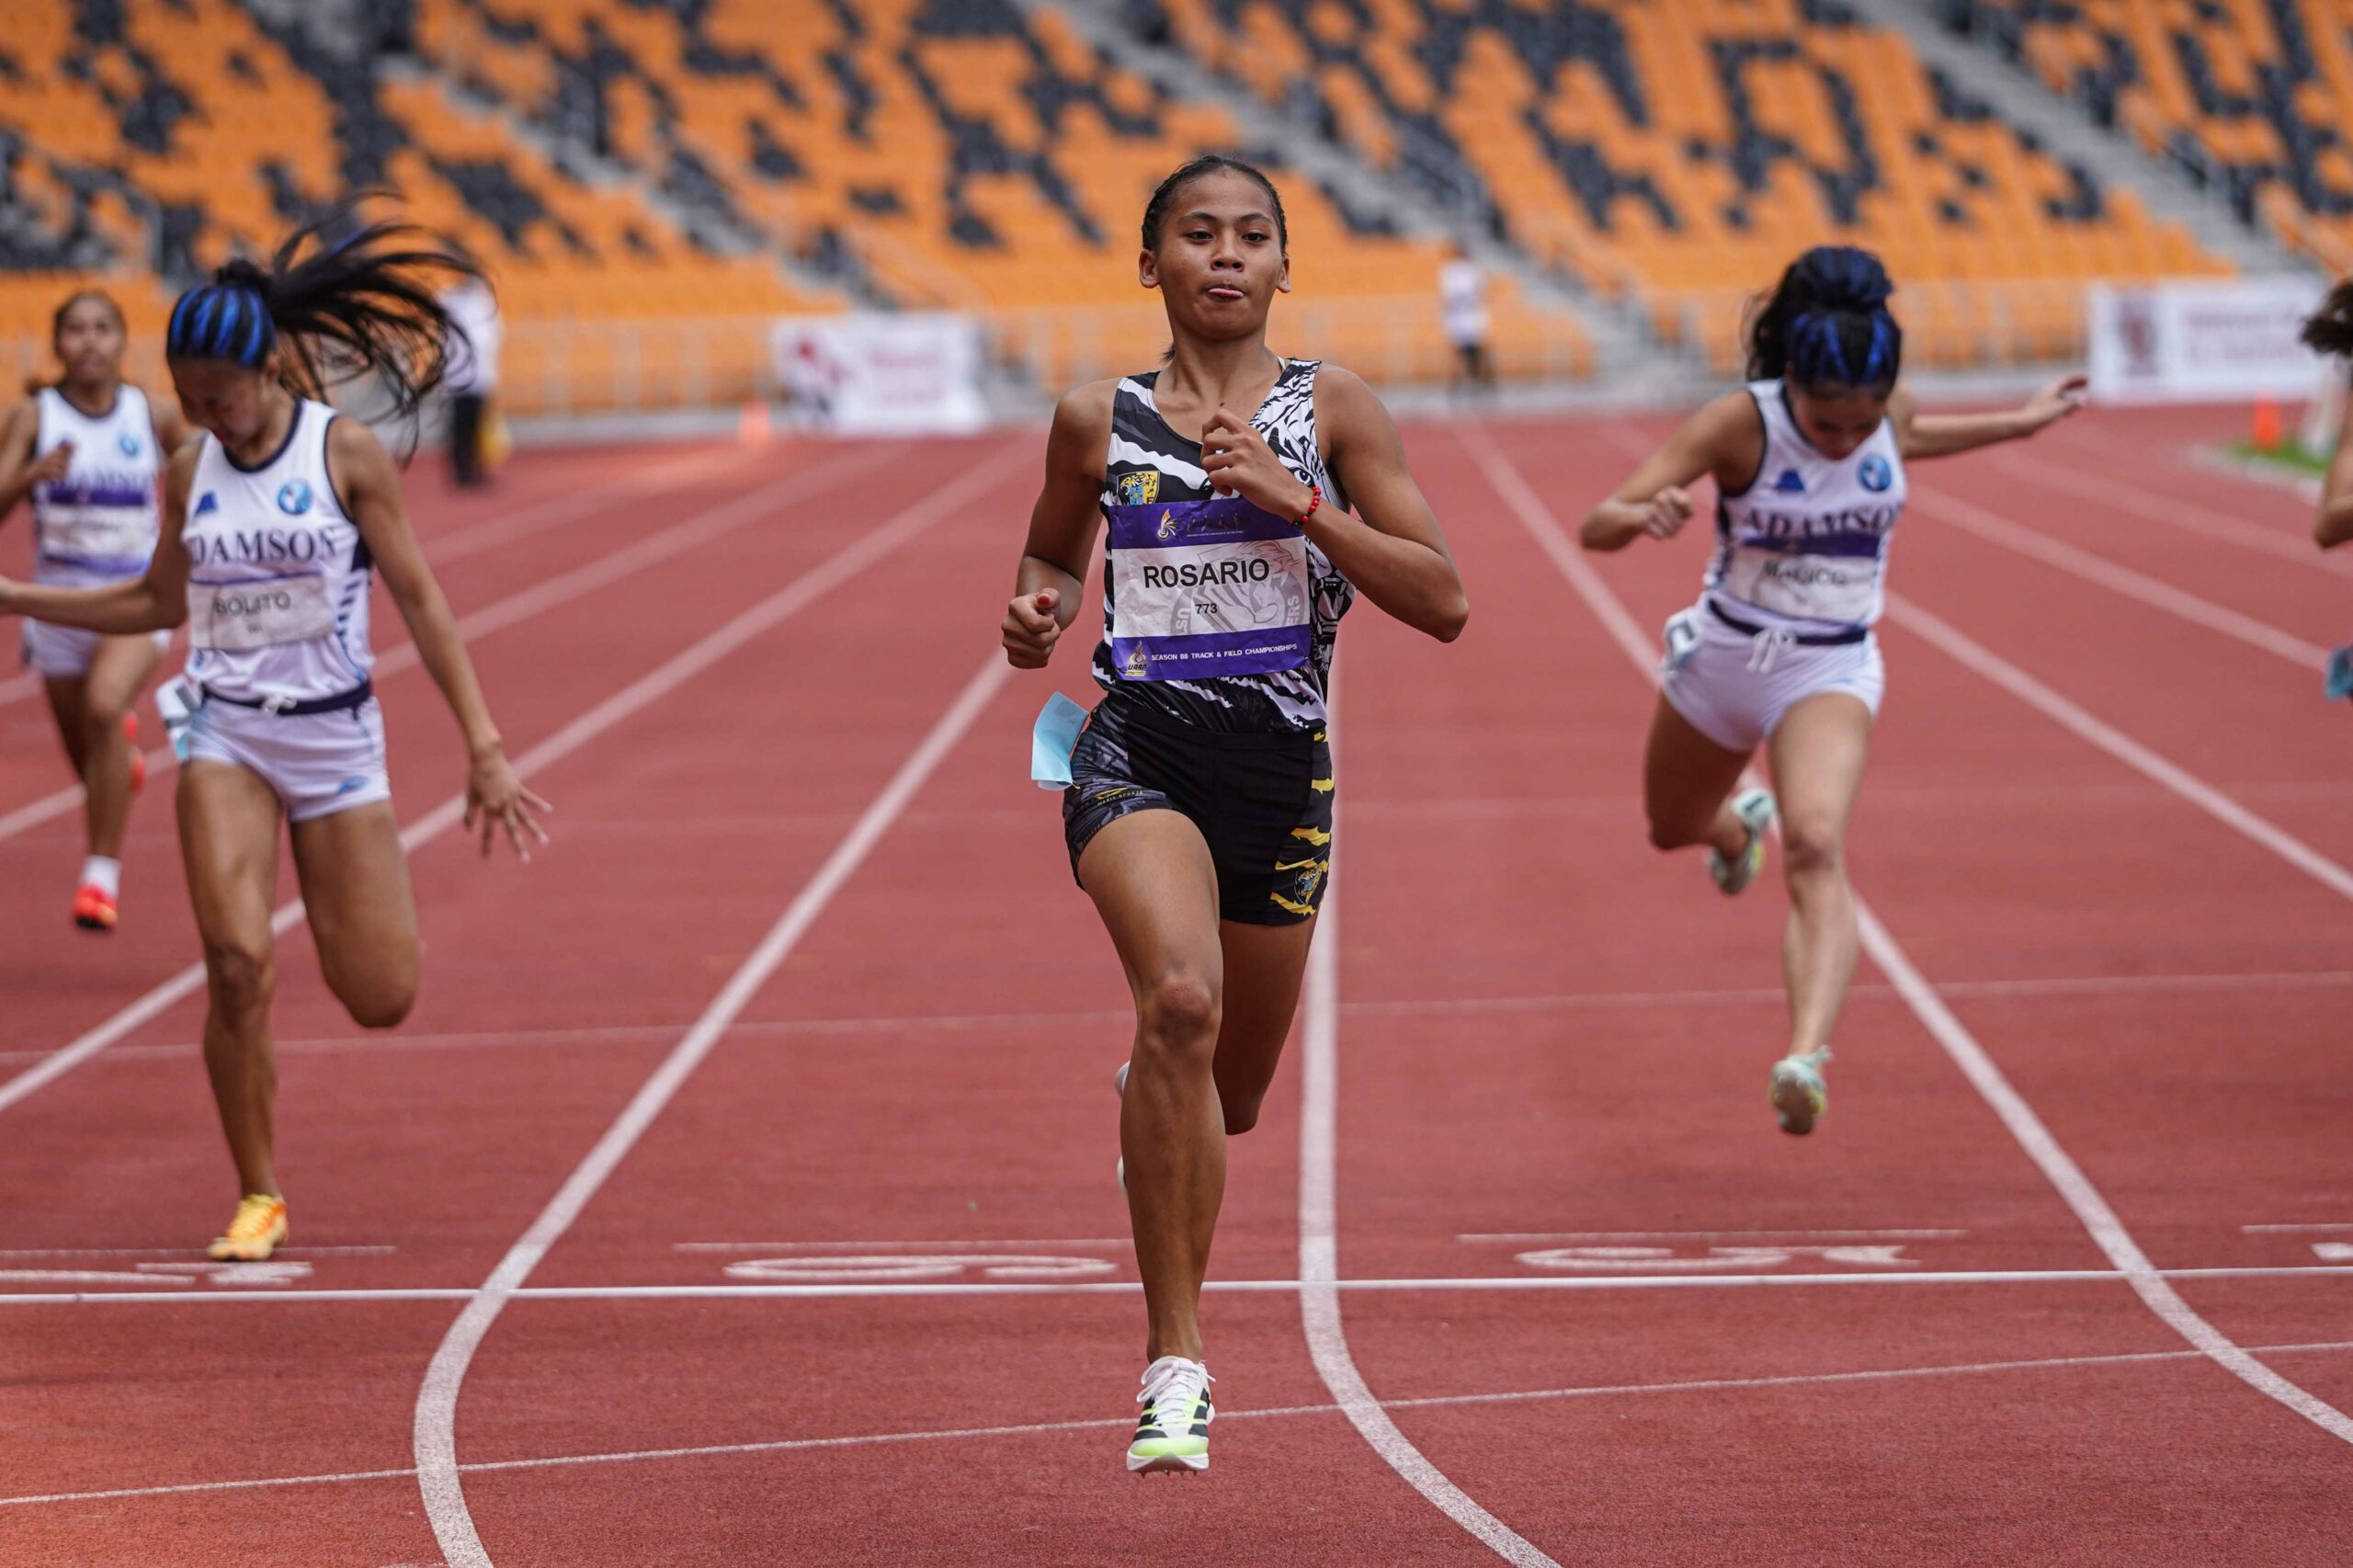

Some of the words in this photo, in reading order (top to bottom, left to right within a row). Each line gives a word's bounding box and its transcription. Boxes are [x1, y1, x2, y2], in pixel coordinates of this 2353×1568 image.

[190, 528, 336, 565] DAMSON
[1142, 558, 1270, 589] ROSARIO
[1195, 603, 1218, 614] 773
[1245, 643, 1298, 655] CHAMPIONSHIPS
